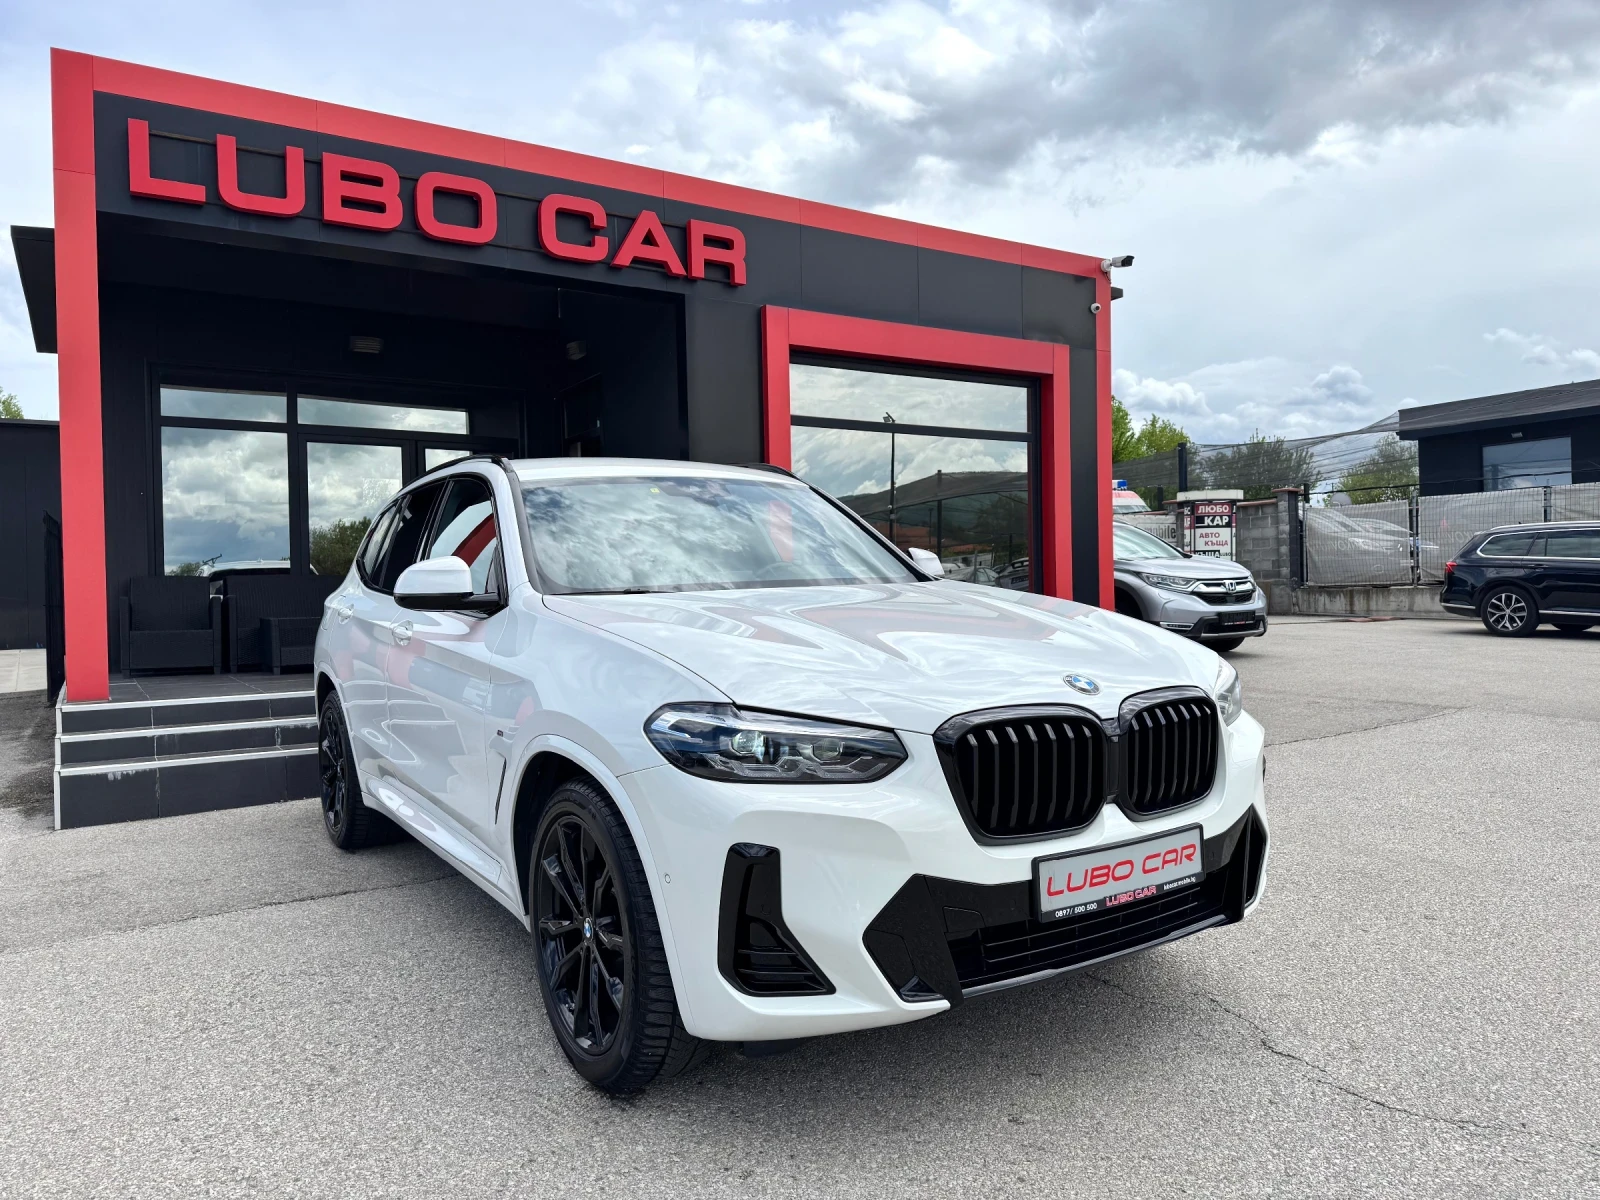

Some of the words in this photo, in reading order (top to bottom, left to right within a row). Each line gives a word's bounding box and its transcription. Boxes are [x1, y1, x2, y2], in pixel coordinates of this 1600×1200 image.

[127, 118, 498, 246] LUBO
[537, 193, 747, 286] CAR
[1197, 504, 1229, 513] ЛЮБО
[1204, 515, 1229, 526] КАР
[1046, 859, 1135, 897] LUBO
[1141, 843, 1197, 875] CAR
[1105, 892, 1134, 907] LUBO
[1135, 885, 1157, 899] CAR
[1055, 908, 1073, 918] 0897/
[1074, 905, 1086, 914] 500
[1086, 902, 1097, 911] 500
